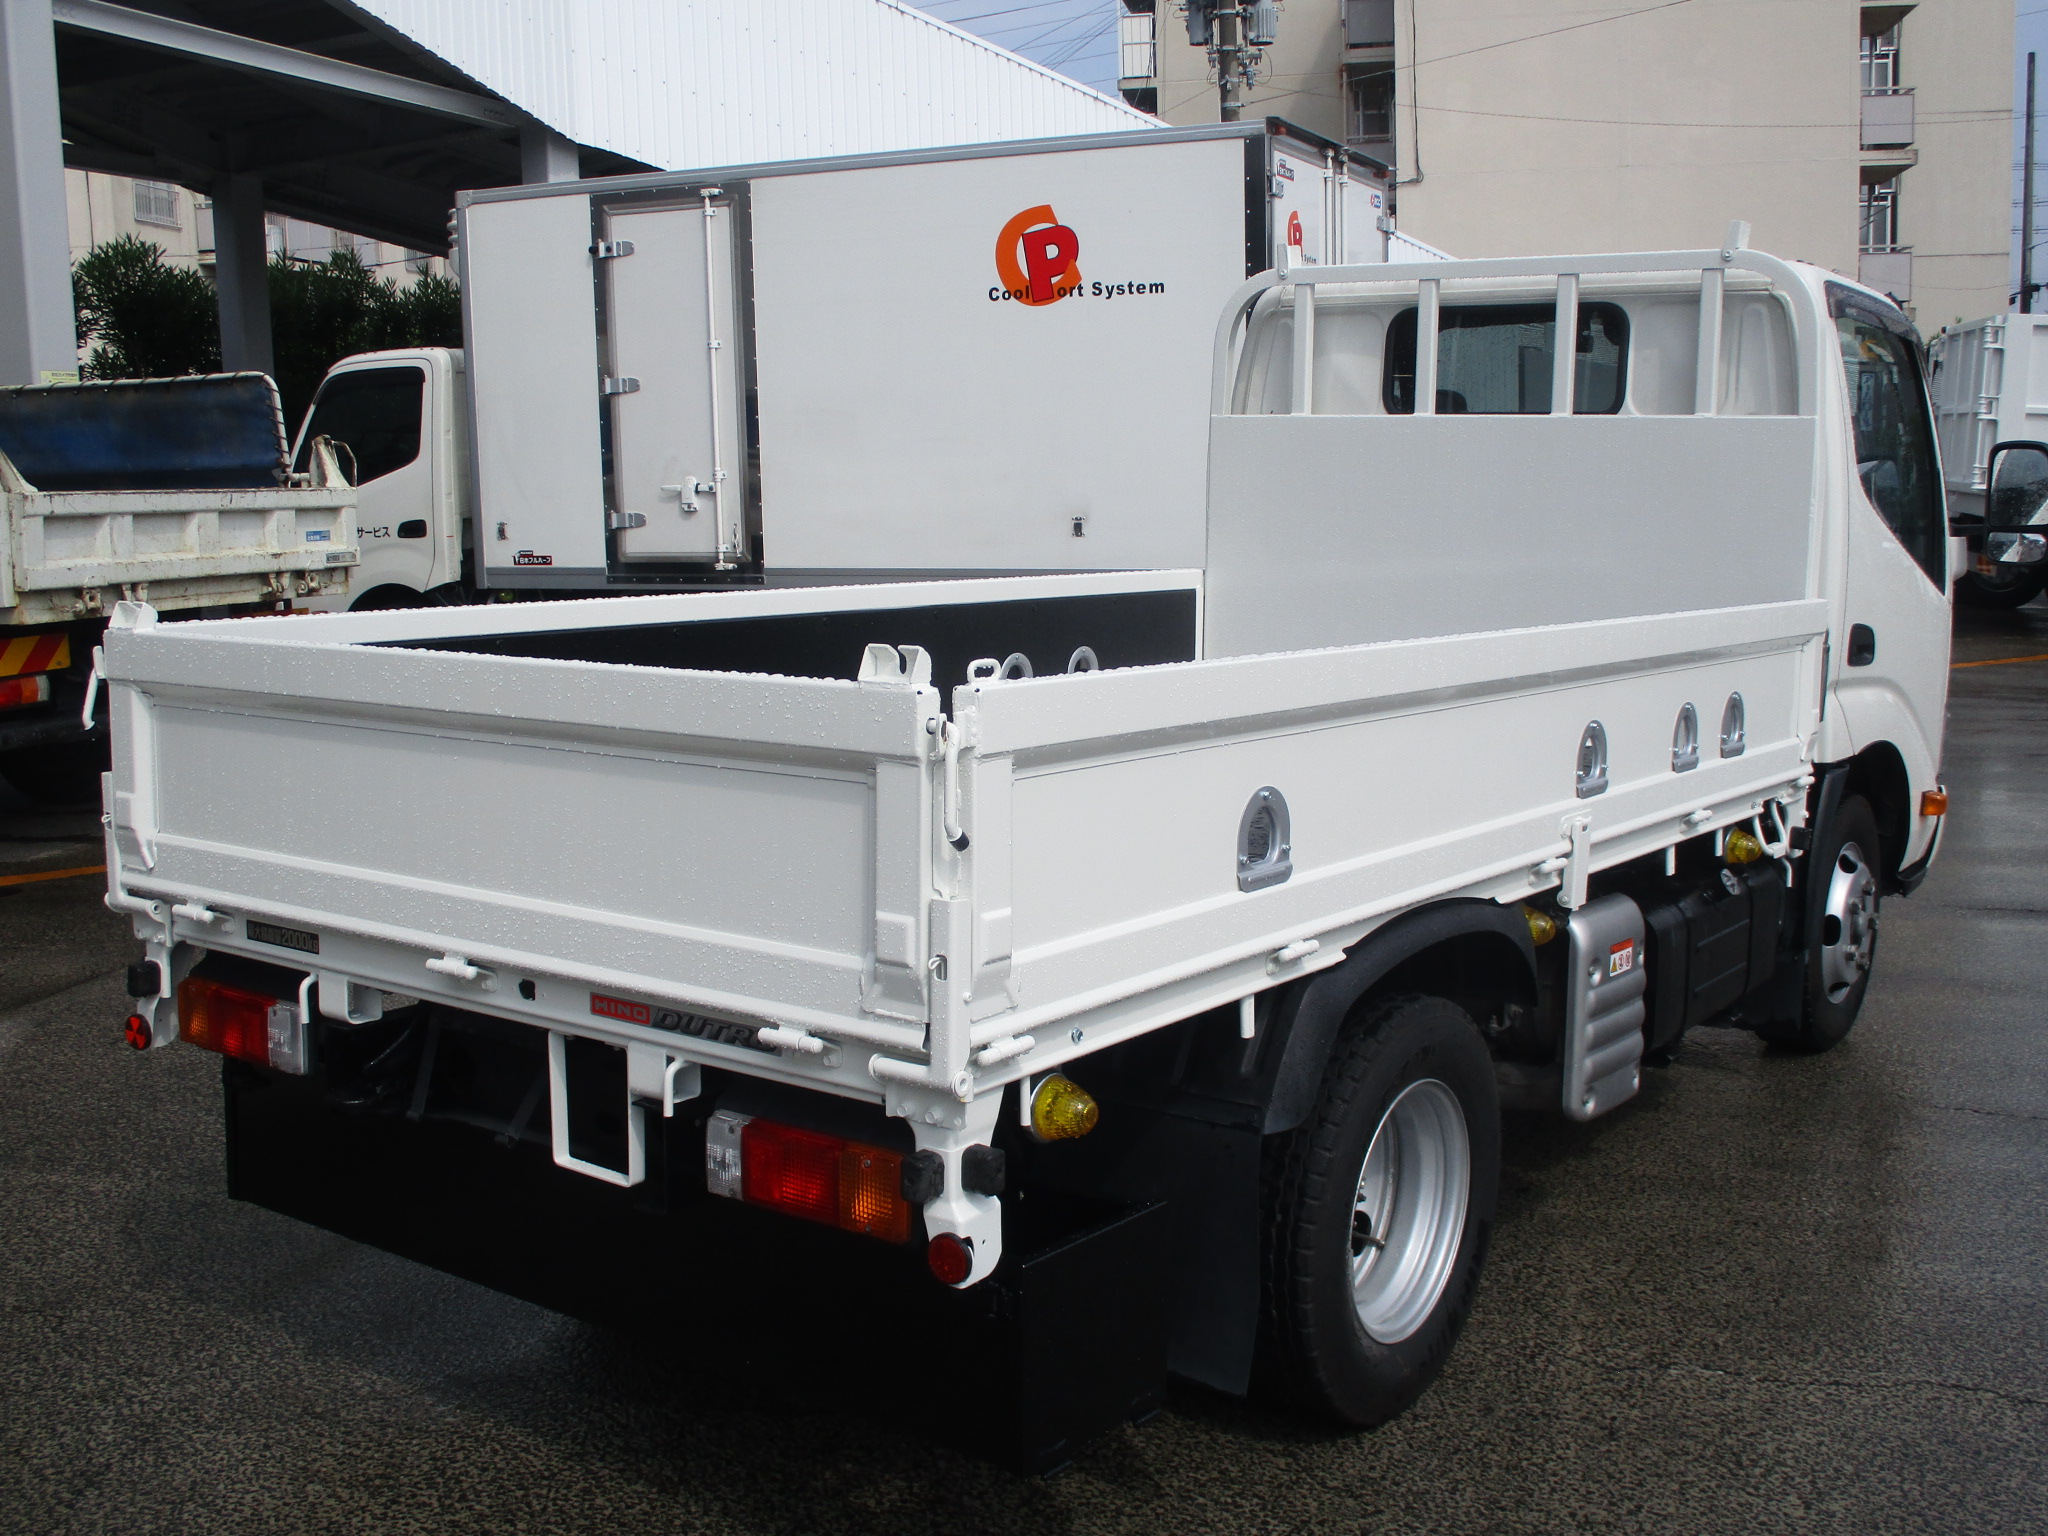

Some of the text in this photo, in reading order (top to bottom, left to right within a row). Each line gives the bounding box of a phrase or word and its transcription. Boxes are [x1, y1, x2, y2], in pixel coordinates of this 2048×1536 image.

[1092, 280, 1165, 299] System
[357, 526, 391, 538] サービス
[594, 999, 648, 1021] HINO
